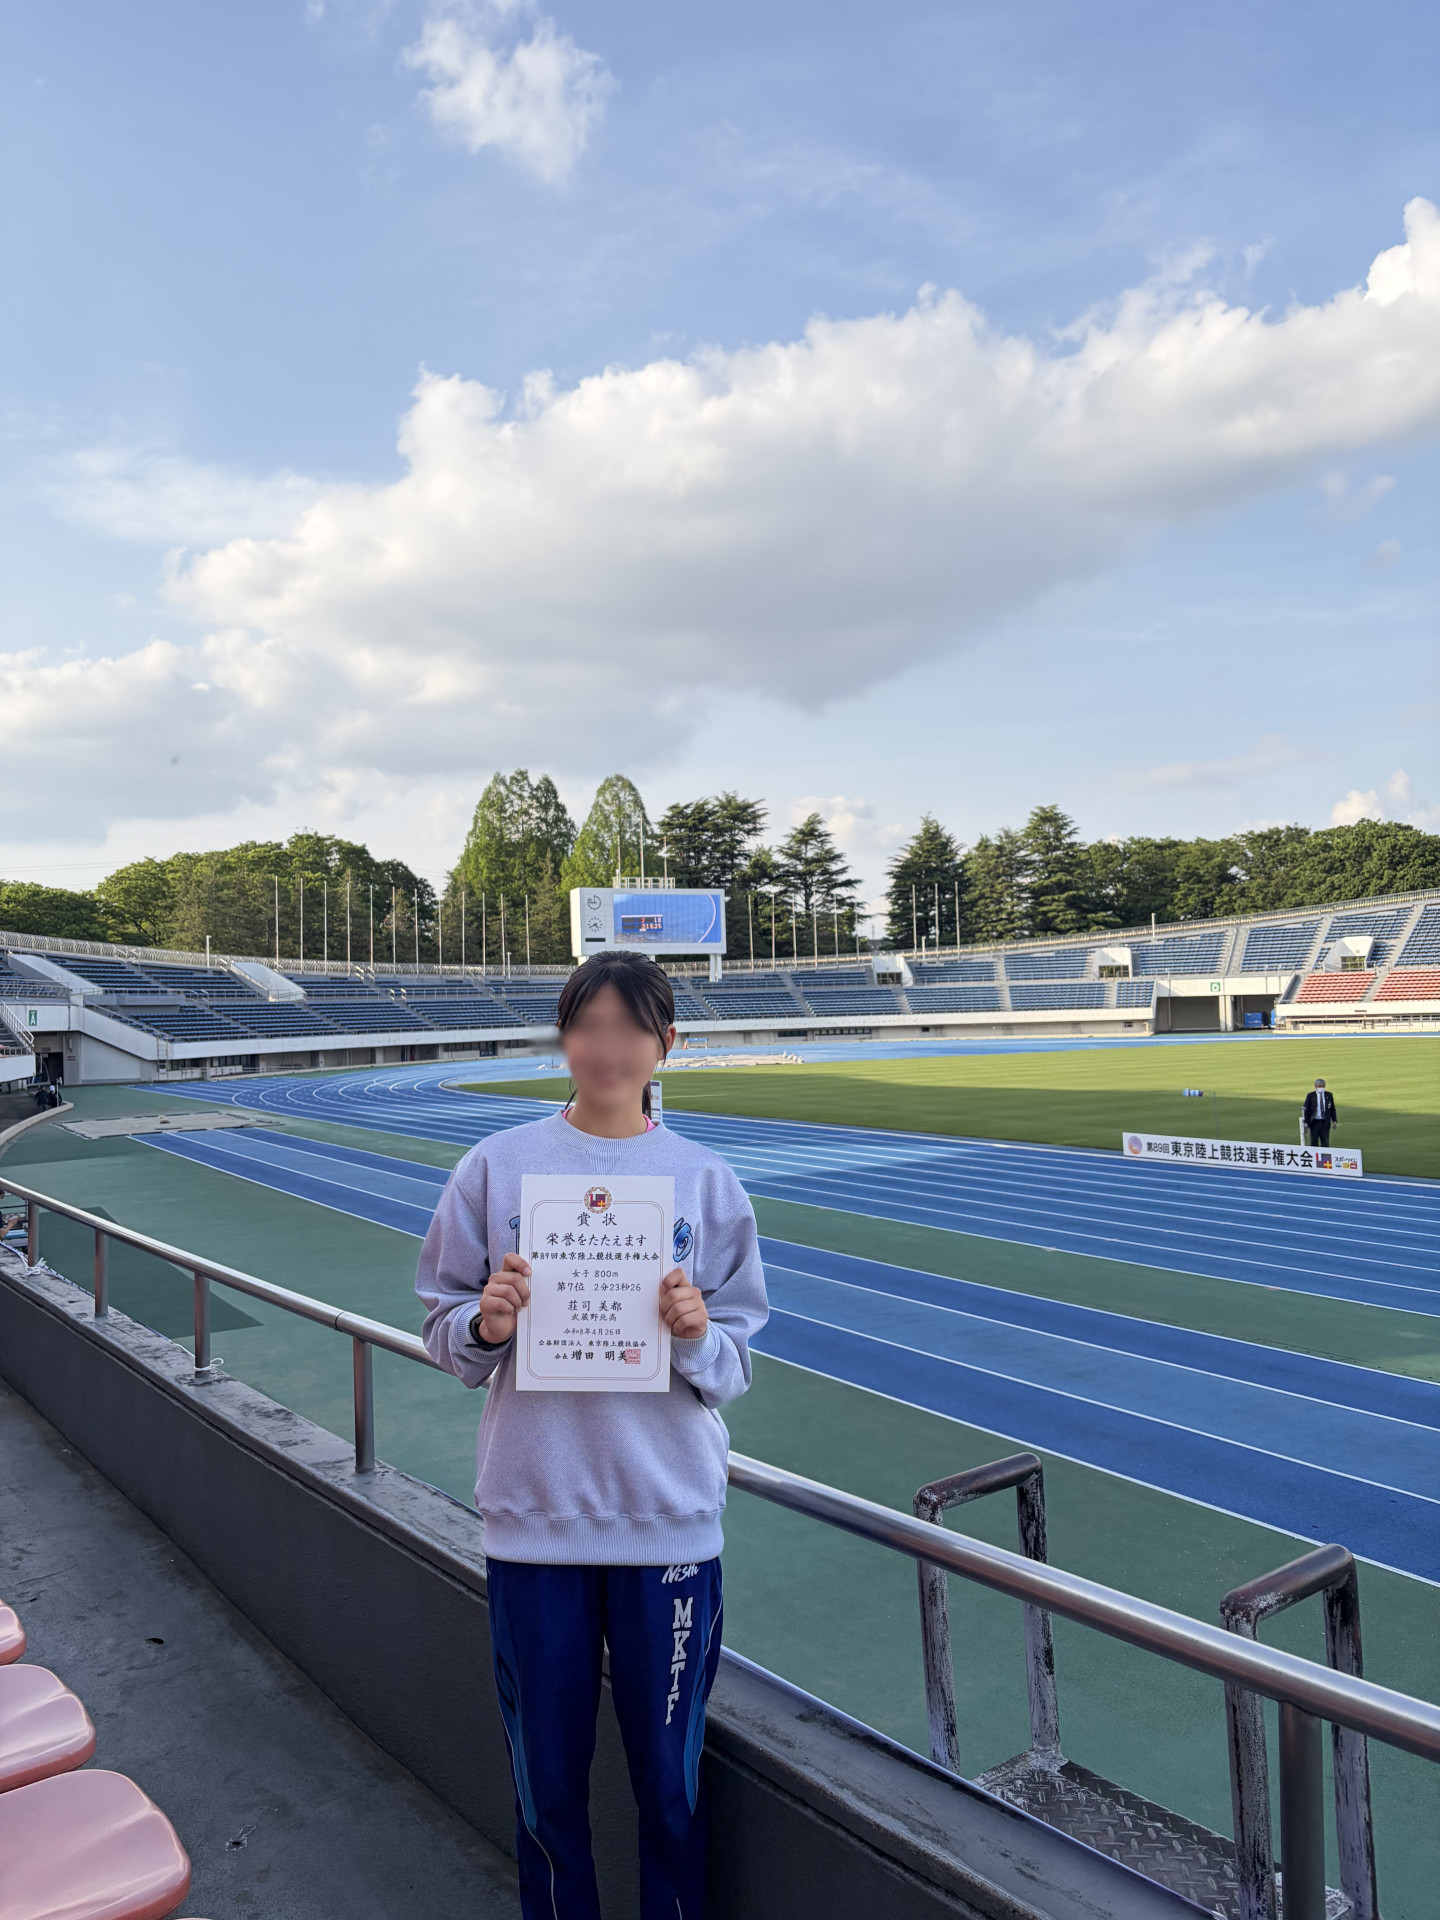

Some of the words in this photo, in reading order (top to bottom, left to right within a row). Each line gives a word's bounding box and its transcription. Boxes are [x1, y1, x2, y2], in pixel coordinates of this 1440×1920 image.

[546, 1232, 647, 1246] 栄誉をたたえます
[531, 1251, 660, 1261] 第89回東京陸上競技選手権大会
[572, 1269, 590, 1278] 女子
[594, 1270, 619, 1278] 800m
[556, 1282, 585, 1292] 第7位
[594, 1282, 641, 1292] 2分23秒26
[571, 1313, 617, 1322] 武蔵野北高
[563, 1327, 621, 1336] 令和8年4月26日
[665, 1597, 693, 1725] MKTF
